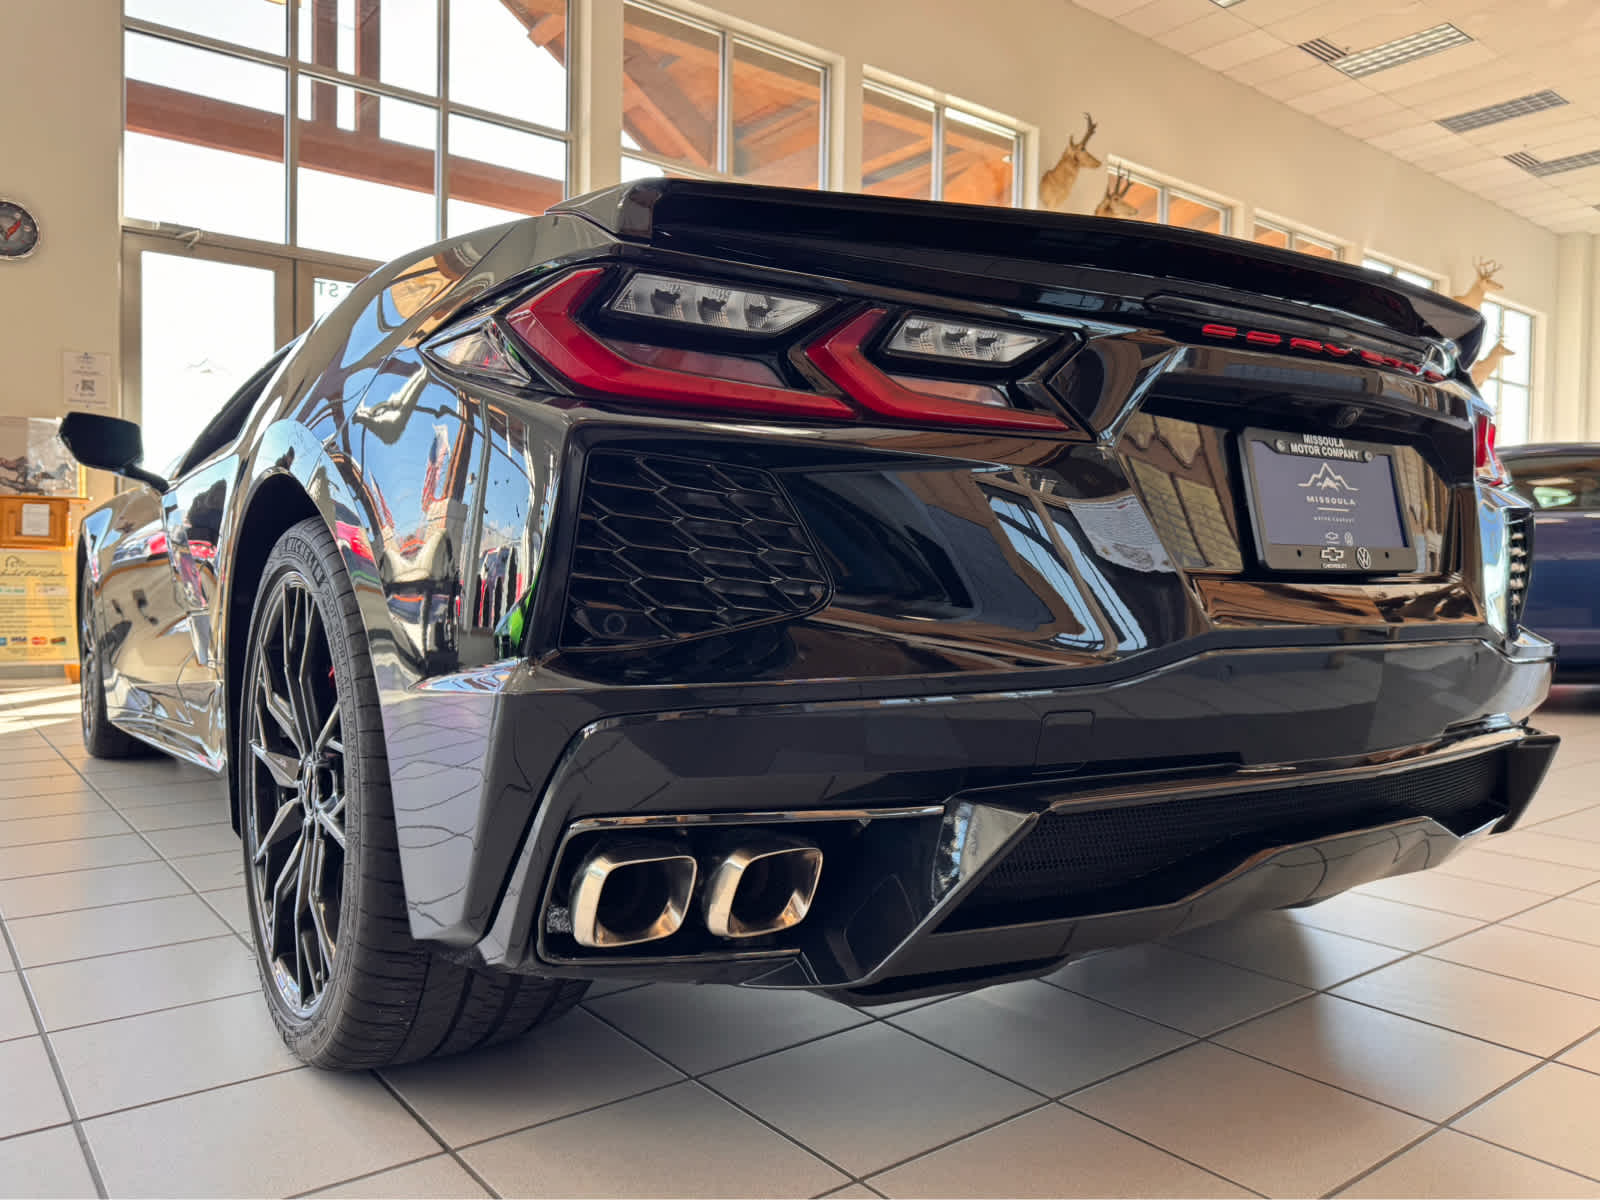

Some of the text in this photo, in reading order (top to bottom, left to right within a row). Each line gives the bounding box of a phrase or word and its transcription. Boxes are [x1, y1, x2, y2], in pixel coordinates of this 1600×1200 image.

[1303, 433, 1344, 449] MISSOULA
[1290, 442, 1359, 461] MOTOR COMPANY
[1306, 495, 1356, 506] MISSOULA
[286, 536, 326, 588] MICHELIN
